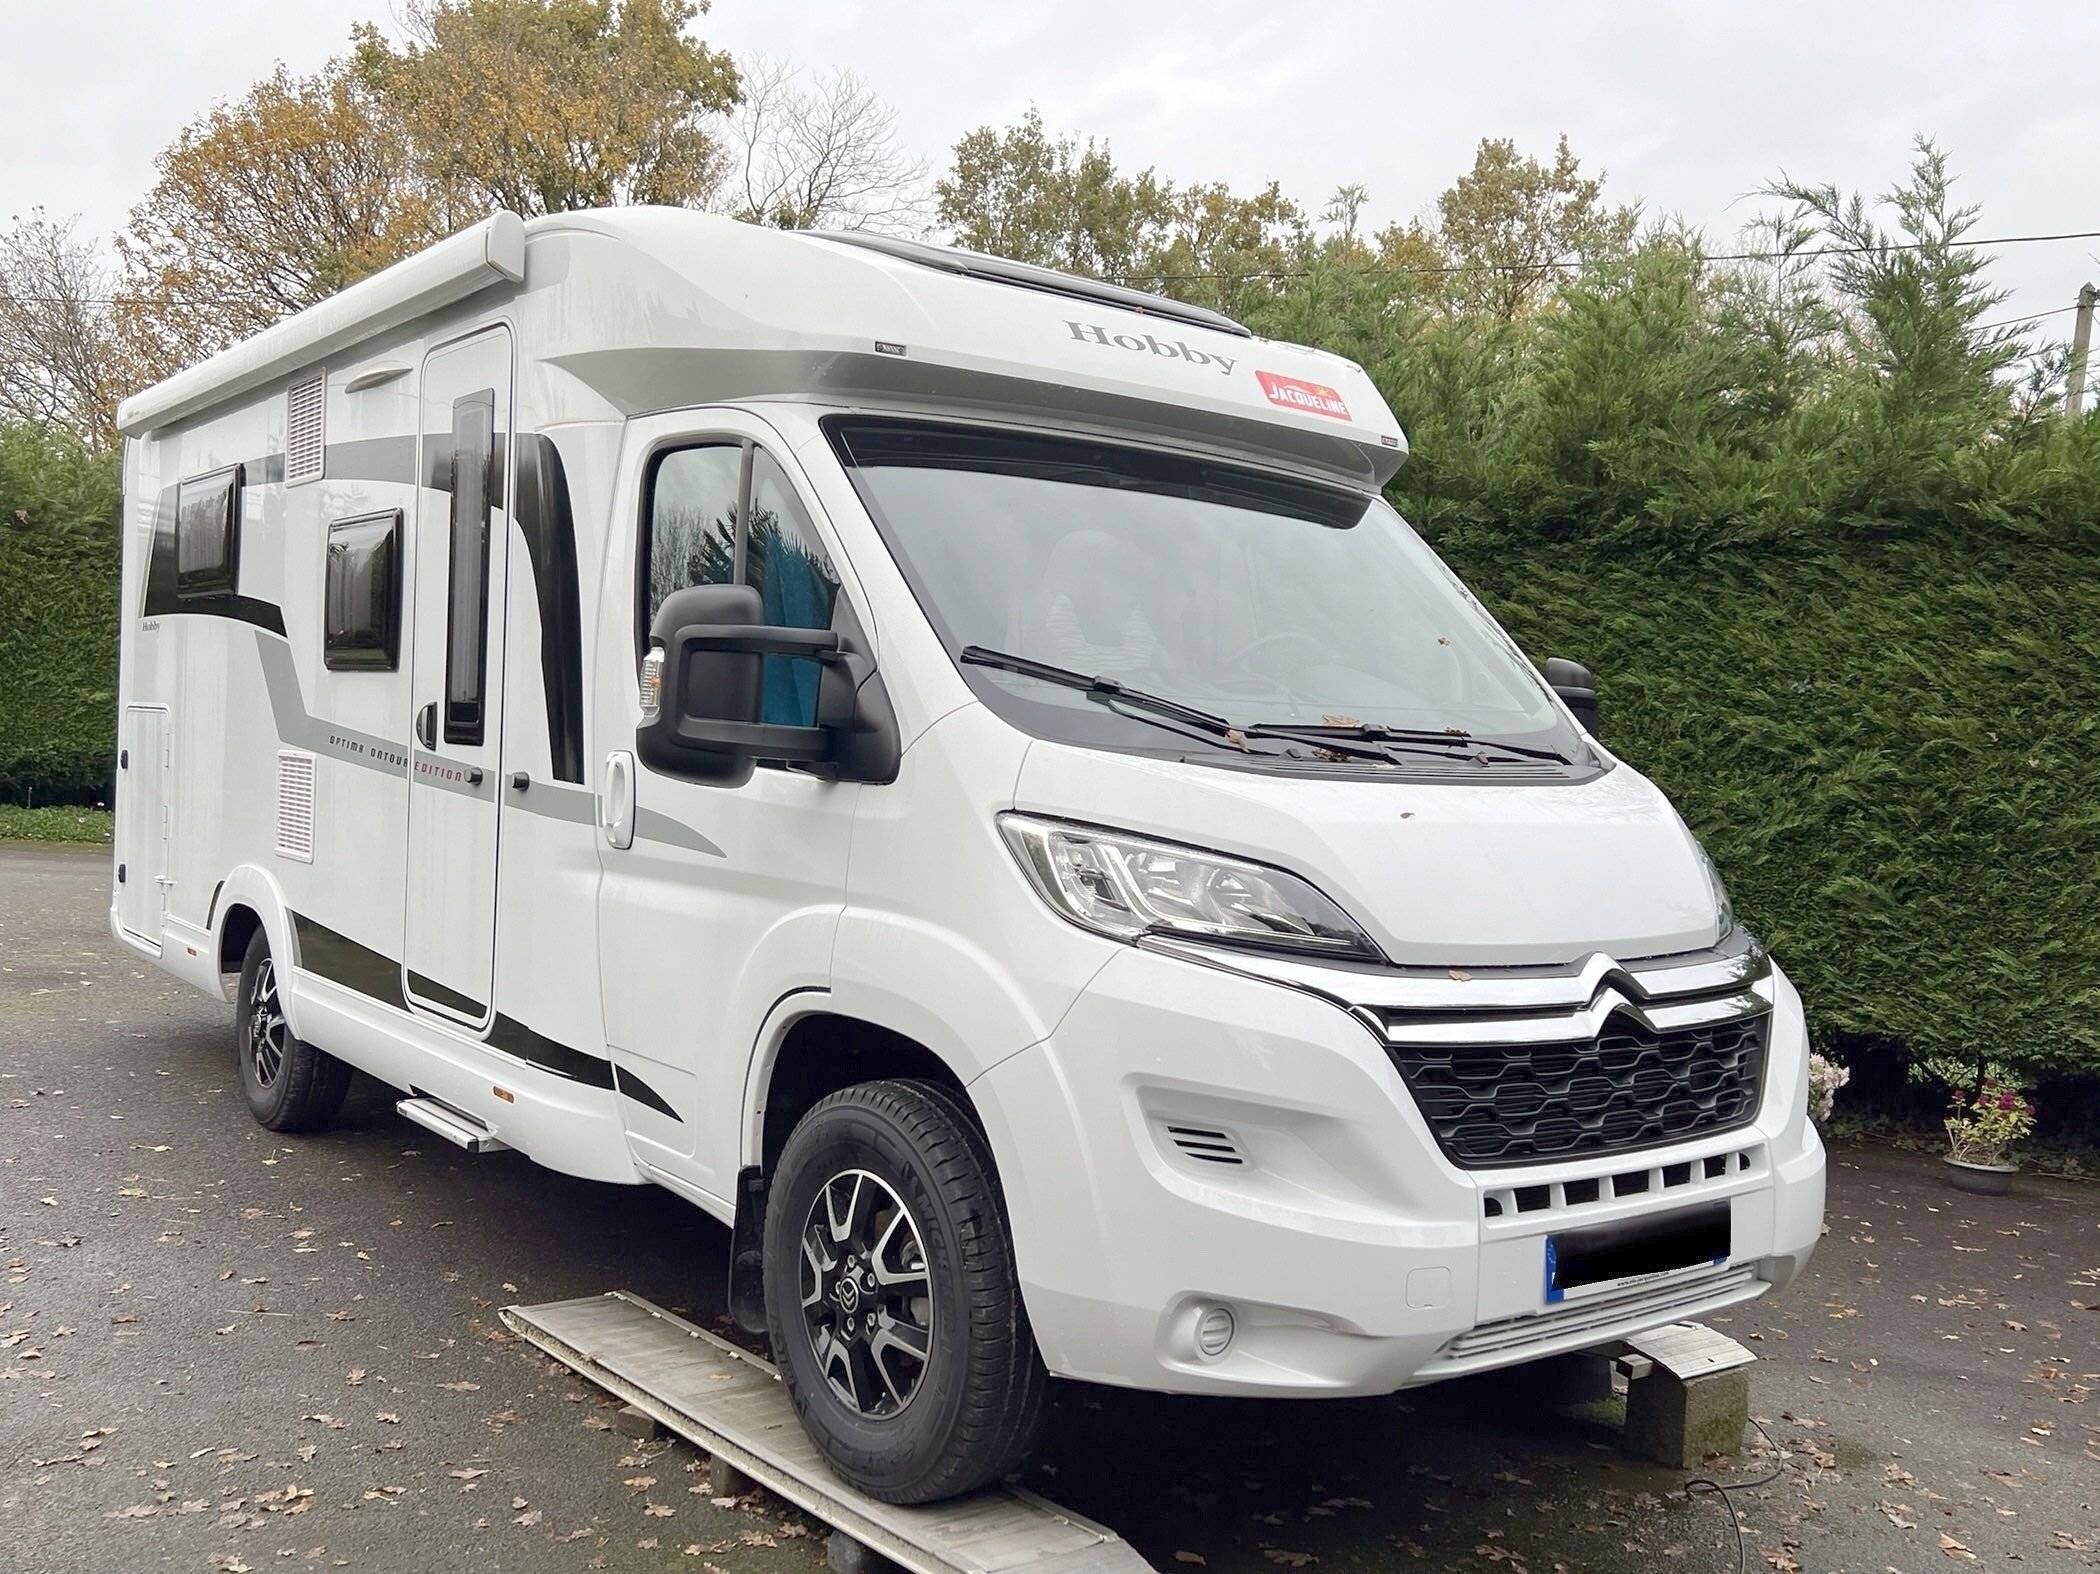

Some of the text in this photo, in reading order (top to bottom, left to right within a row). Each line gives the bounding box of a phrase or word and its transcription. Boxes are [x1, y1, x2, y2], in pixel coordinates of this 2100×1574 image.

[1062, 319, 1239, 376] Hobby
[1268, 382, 1349, 415] JACQUELINE
[329, 735, 462, 781] OPTIMA ONTOUR EDITION
